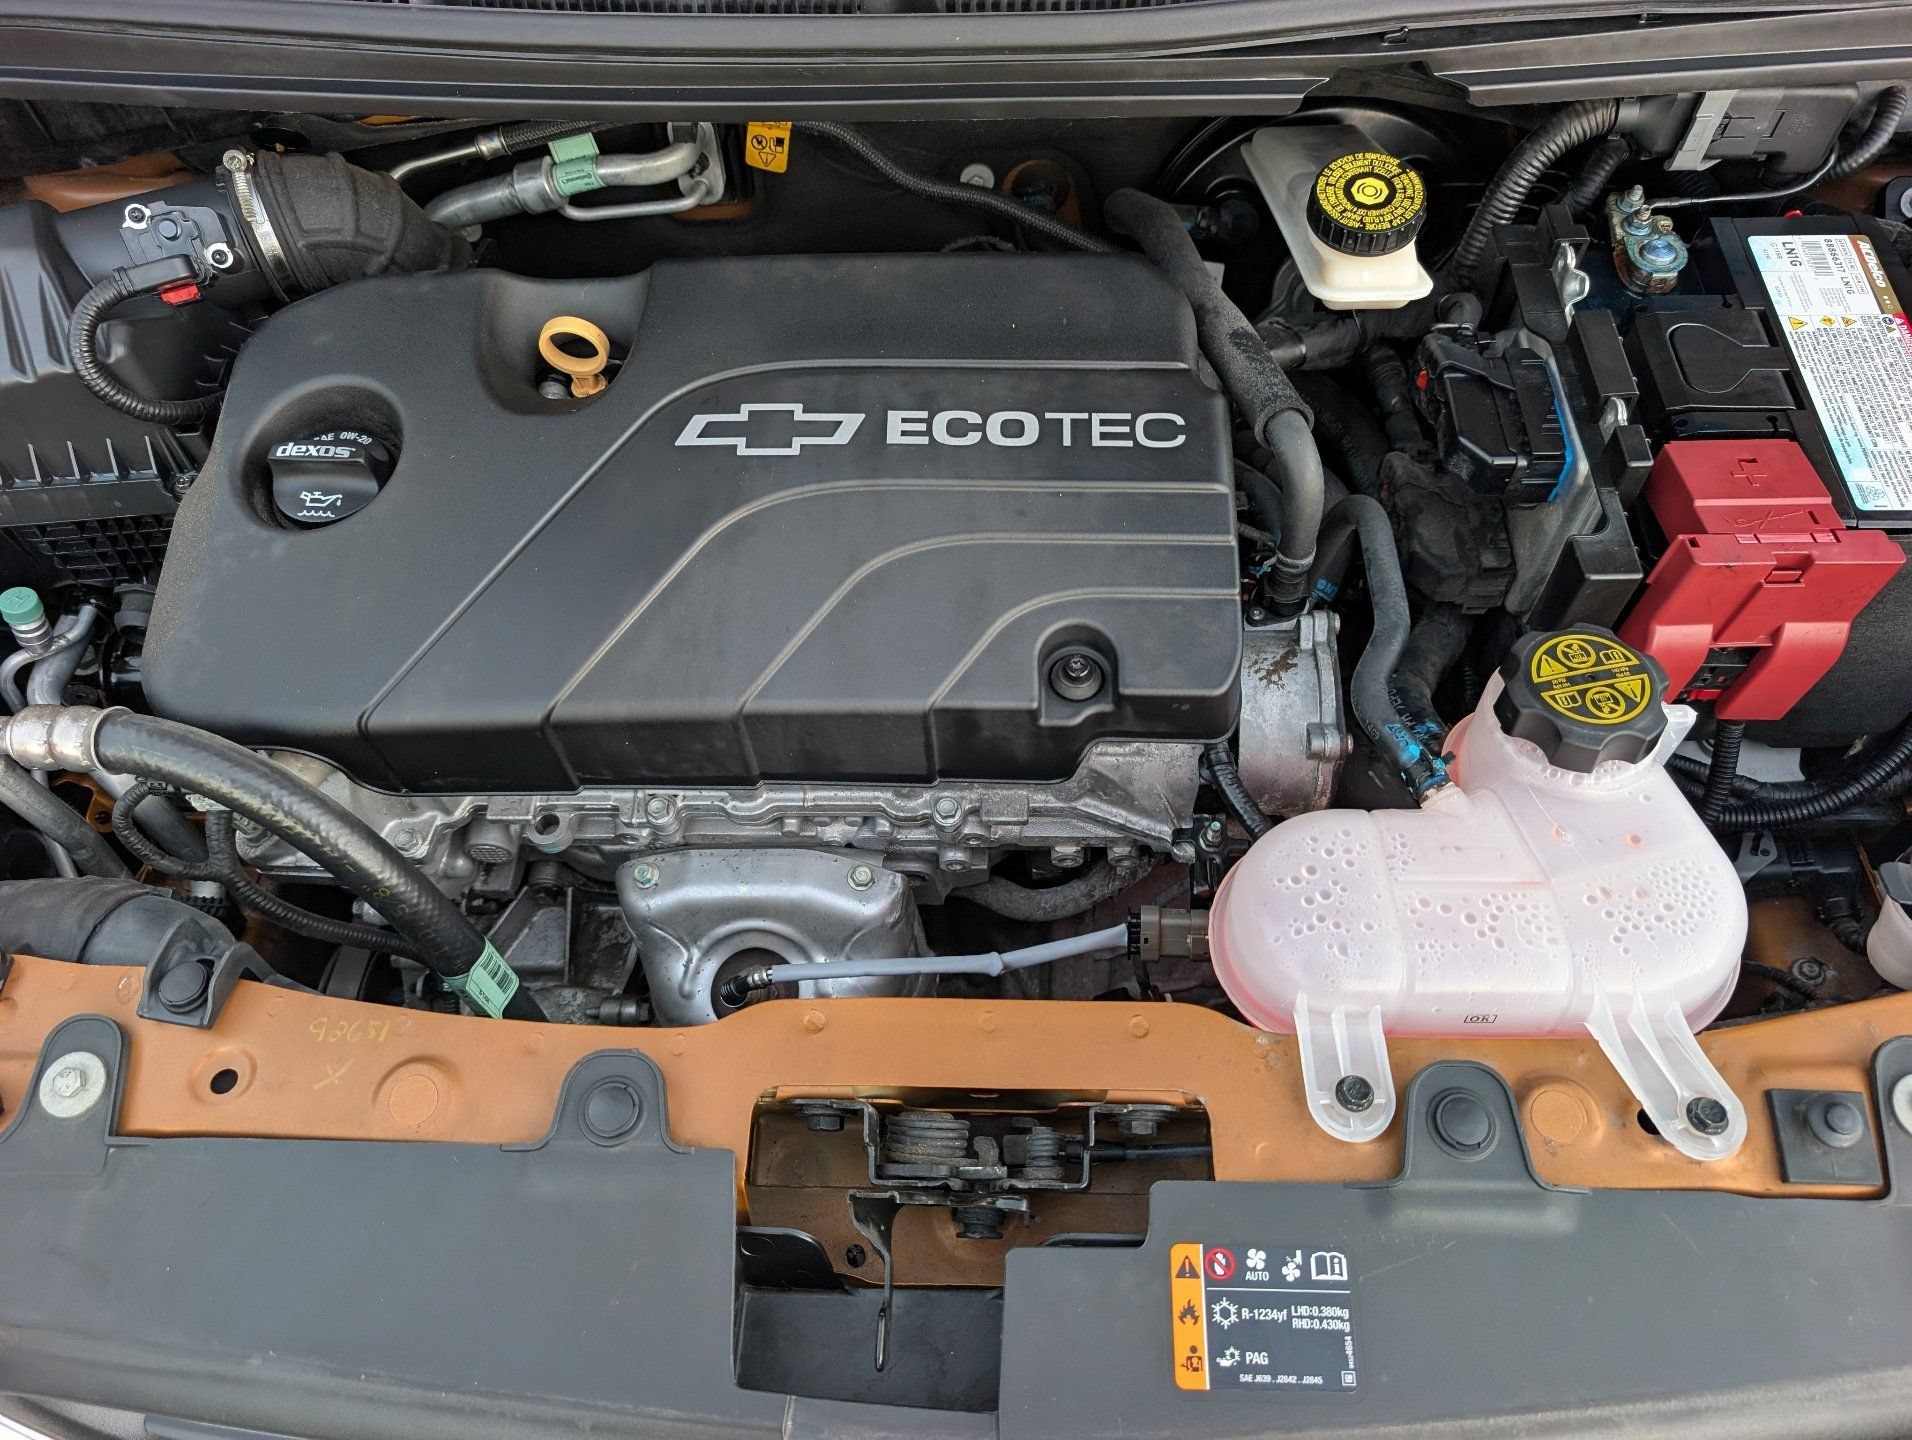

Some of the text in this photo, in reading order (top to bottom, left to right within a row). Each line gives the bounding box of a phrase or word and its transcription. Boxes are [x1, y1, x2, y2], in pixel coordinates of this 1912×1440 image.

[1782, 241, 1803, 267] LN1G
[1824, 238, 1846, 273] 88866317
[1841, 276, 1856, 295] LN1G
[1856, 239, 1887, 288] ACDelco
[886, 410, 1187, 448] ECOTEC
[340, 431, 373, 445] 0W-20
[276, 442, 356, 458] dexos
[1245, 1271, 1269, 1281] AUTO
[1241, 1305, 1350, 1323] R-1234yf LHD:0.380kg
[1292, 1318, 1351, 1332] RHD:0.430kg
[1245, 1352, 1269, 1365] PAG
[1239, 1373, 1253, 1382] SAE
[1276, 1374, 1297, 1384] J2842
[1302, 1375, 1323, 1384] J2845
